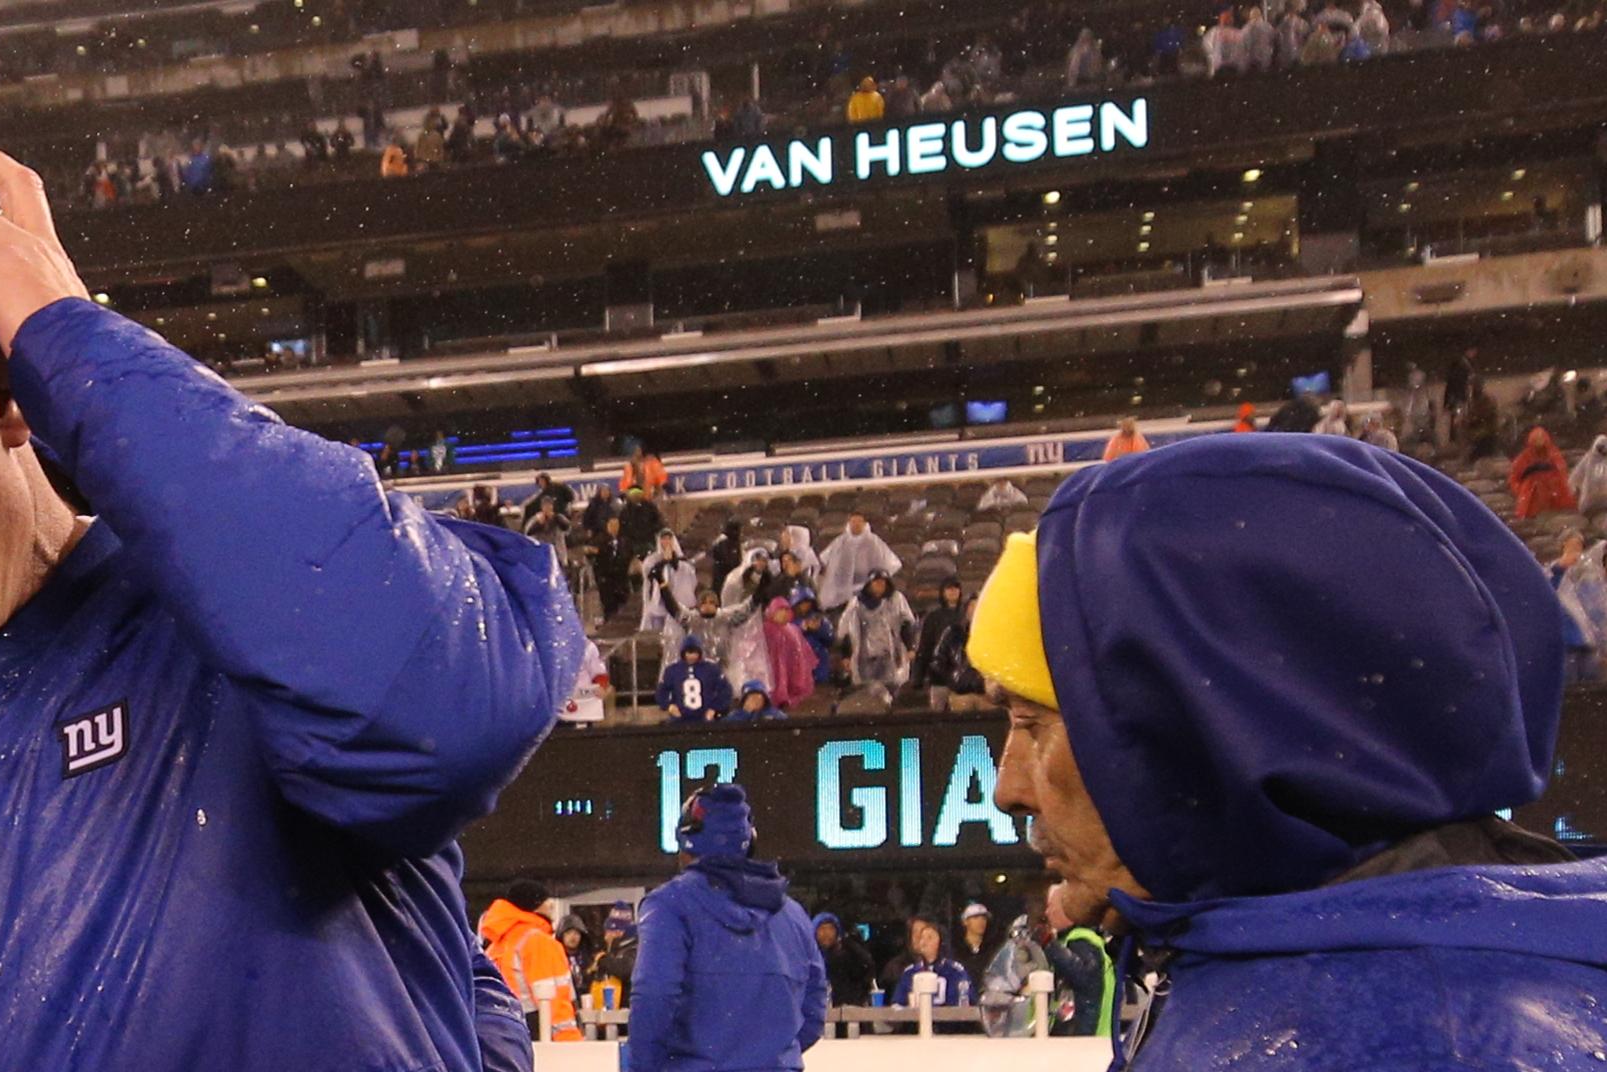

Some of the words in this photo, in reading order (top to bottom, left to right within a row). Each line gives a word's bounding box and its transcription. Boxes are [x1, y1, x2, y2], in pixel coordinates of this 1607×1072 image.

[702, 136, 832, 196] VAN
[855, 98, 1148, 181] HEUSEN
[707, 463, 851, 493] FOOTBALL
[872, 453, 980, 478] GIANTS
[683, 677, 703, 711] 8
[816, 734, 1032, 850] GIA
